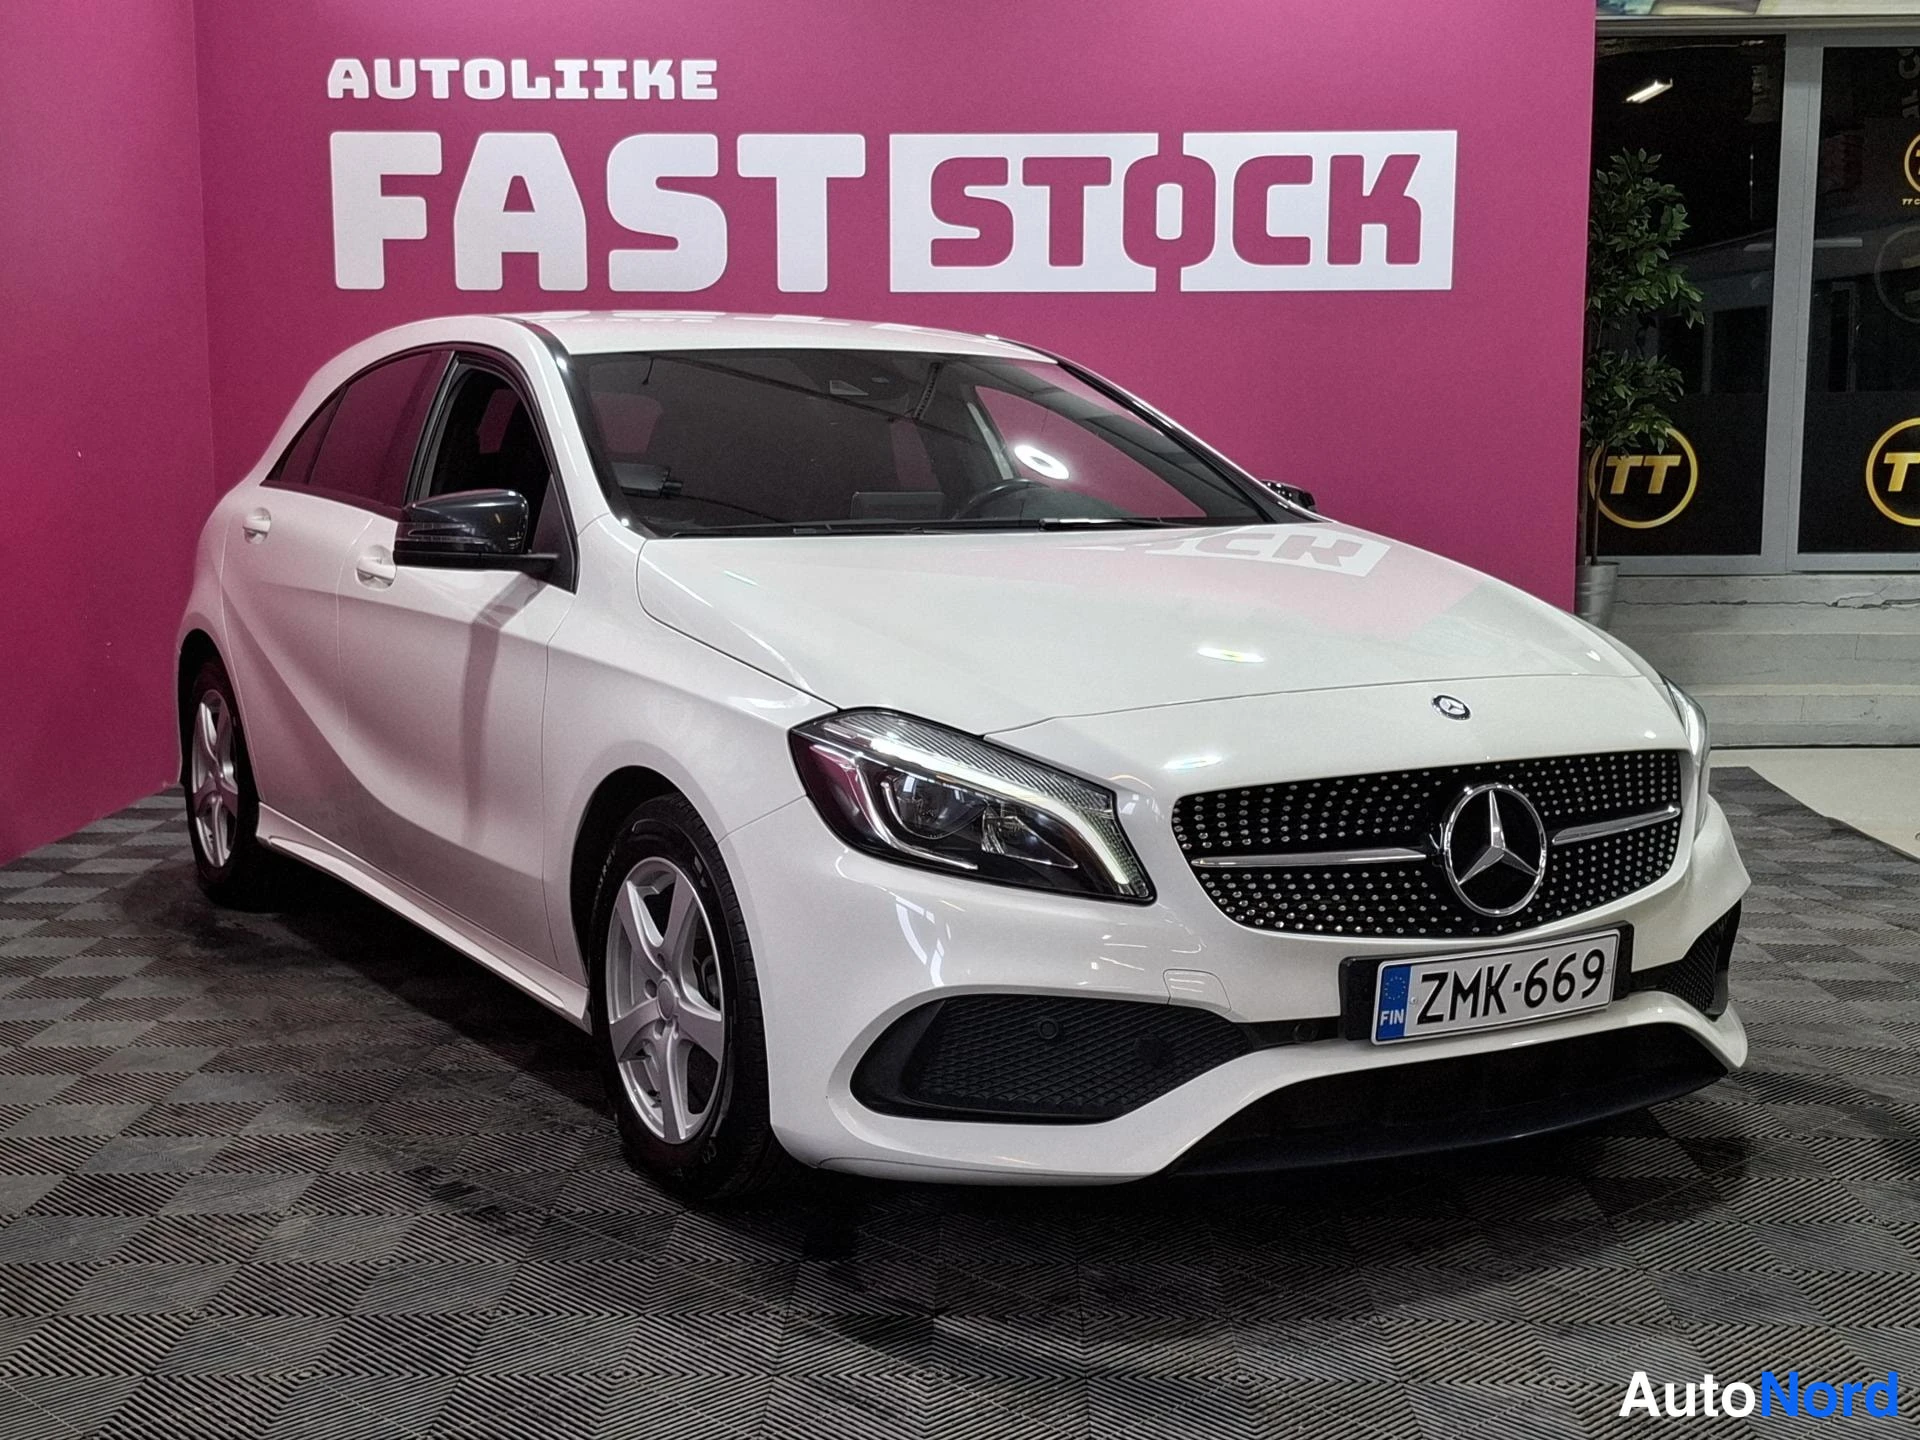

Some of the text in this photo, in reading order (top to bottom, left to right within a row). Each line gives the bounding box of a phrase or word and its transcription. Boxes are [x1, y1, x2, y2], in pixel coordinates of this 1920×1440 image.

[327, 58, 718, 100] AUTOLIIKE
[330, 131, 1422, 293] FAST STOCK
[1605, 455, 1682, 495] TT
[1380, 948, 1605, 1026] FIN ZMK-669
